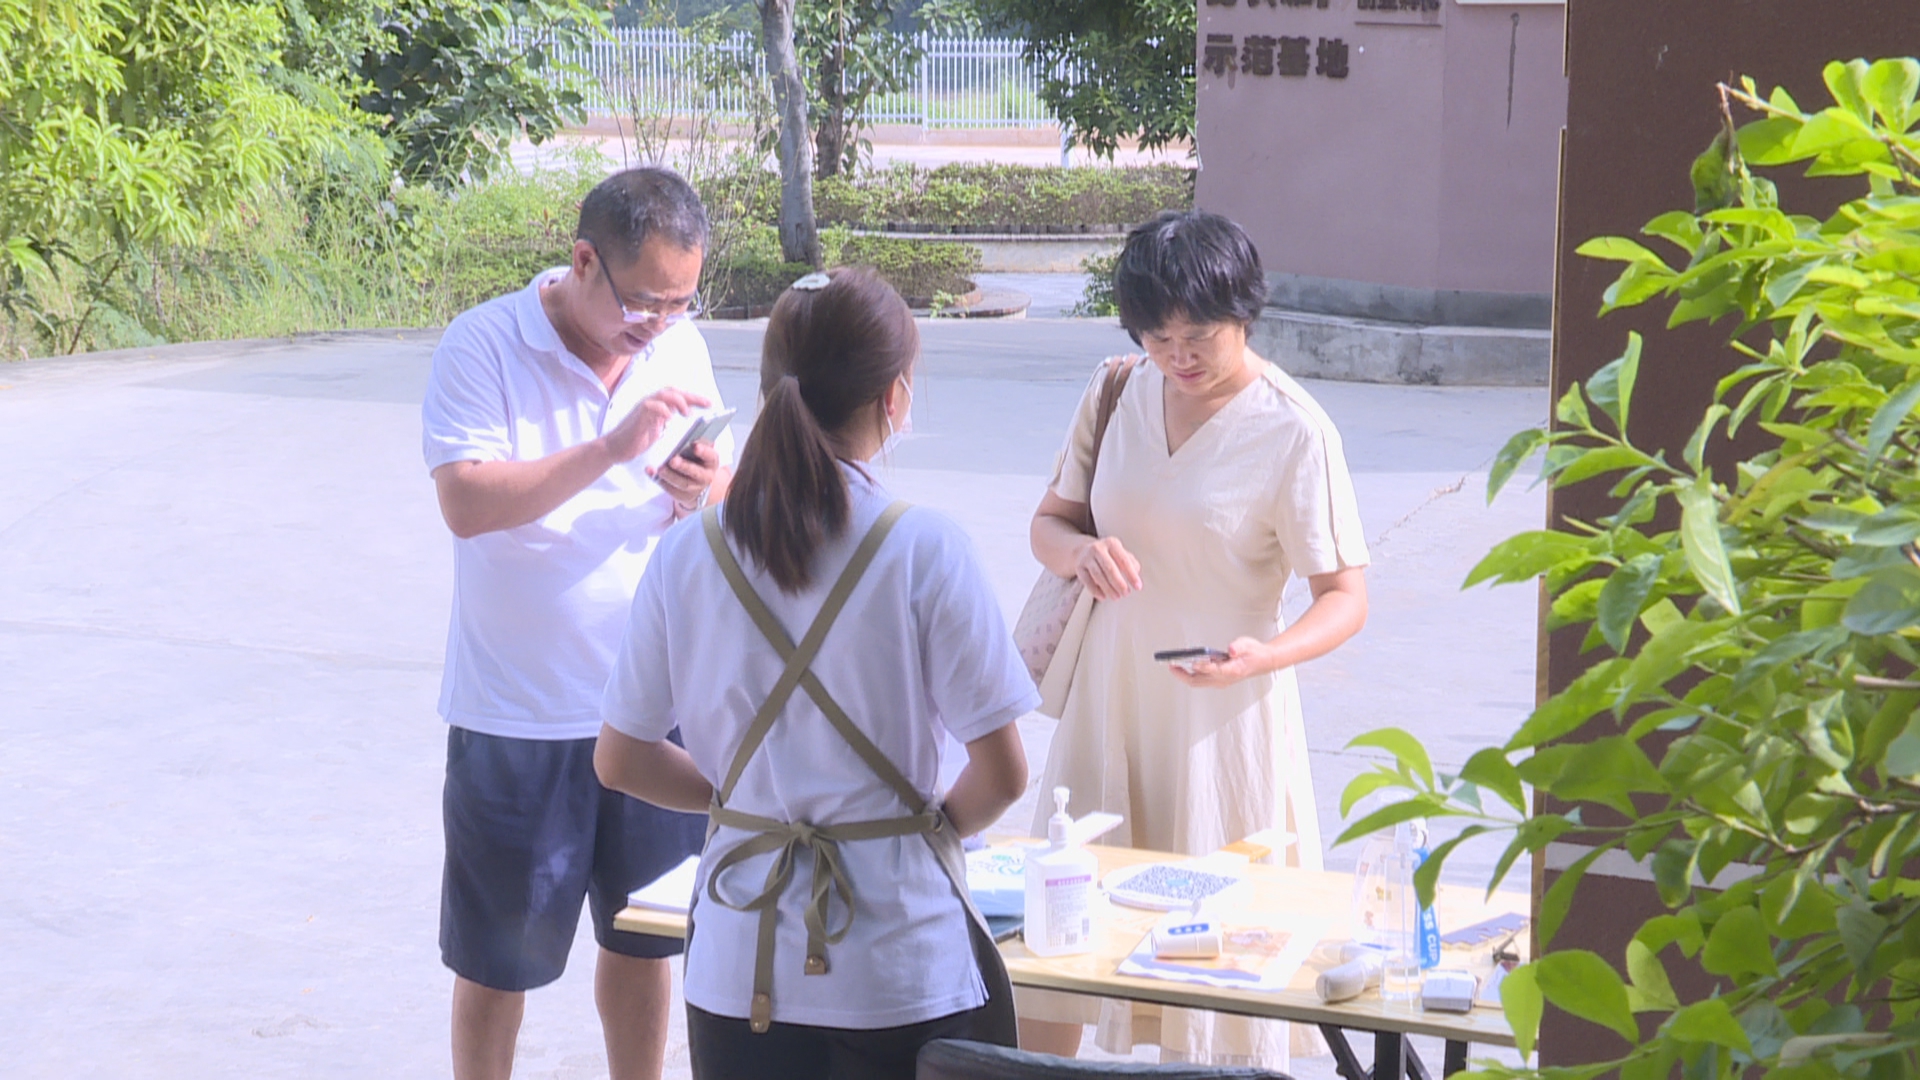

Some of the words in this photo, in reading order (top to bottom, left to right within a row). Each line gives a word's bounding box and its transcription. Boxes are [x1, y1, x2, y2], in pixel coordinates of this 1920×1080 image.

[1203, 34, 1349, 78] 示范基地
[1427, 933, 1438, 961] CUP
